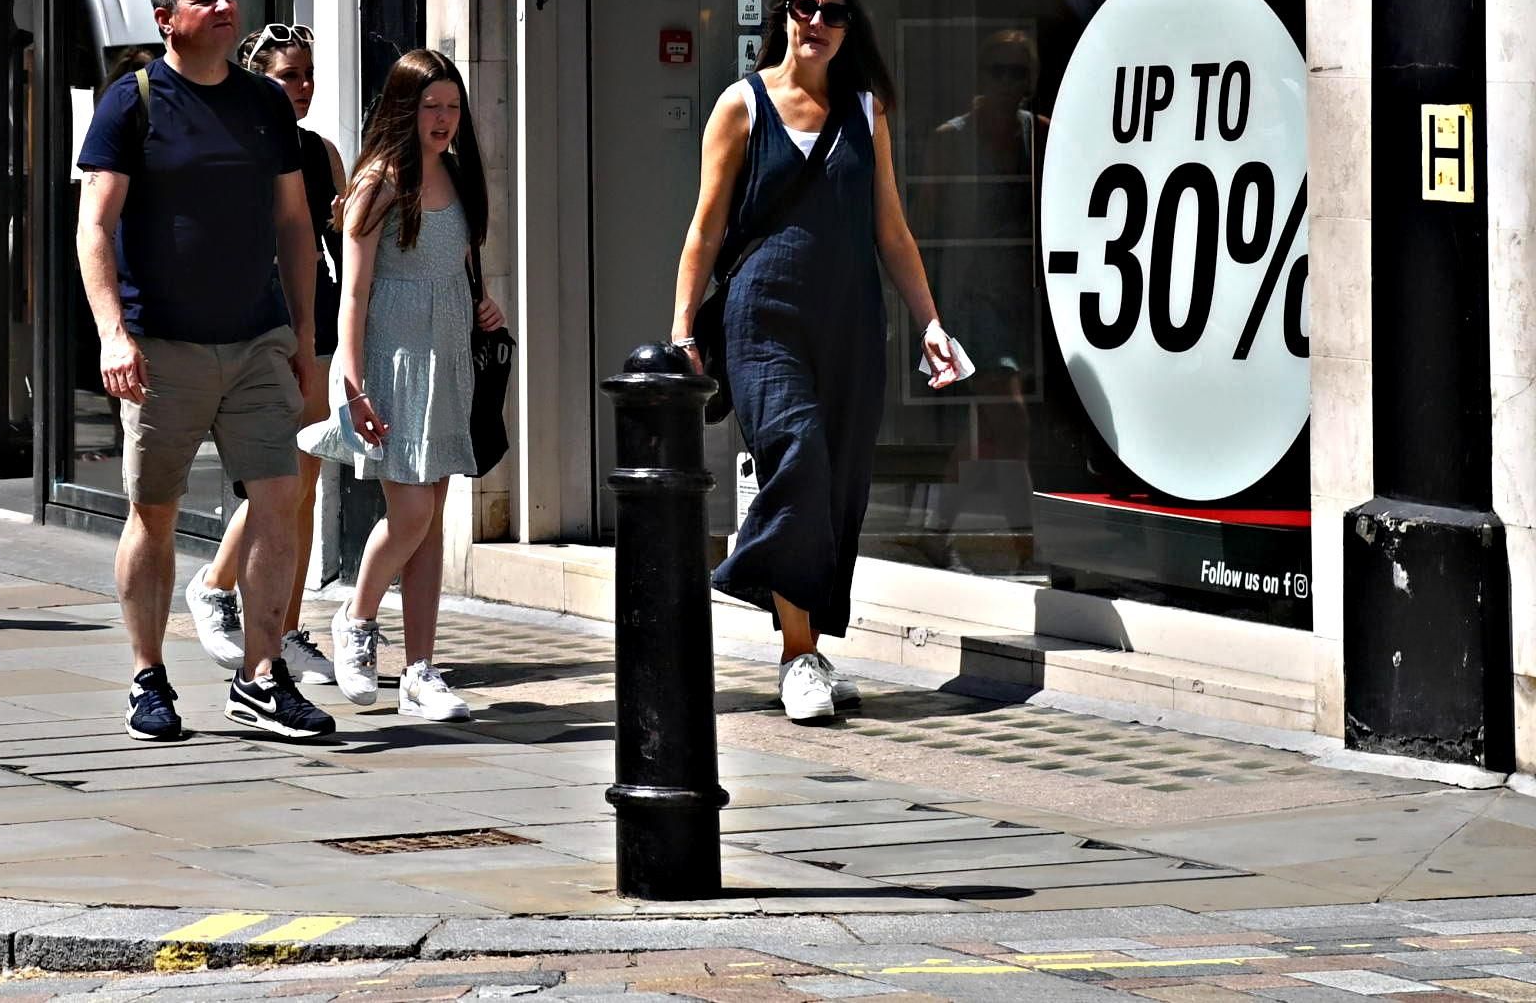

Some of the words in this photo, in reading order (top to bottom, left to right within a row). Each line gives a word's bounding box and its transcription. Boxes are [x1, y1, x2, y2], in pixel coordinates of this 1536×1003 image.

[1112, 65, 1174, 144] UP
[1190, 60, 1251, 142] TO
[1429, 114, 1465, 192] H
[1048, 161, 1309, 361] -30%
[1201, 559, 1243, 589] Follow
[1244, 572, 1260, 591] us
[1263, 575, 1279, 595] on
